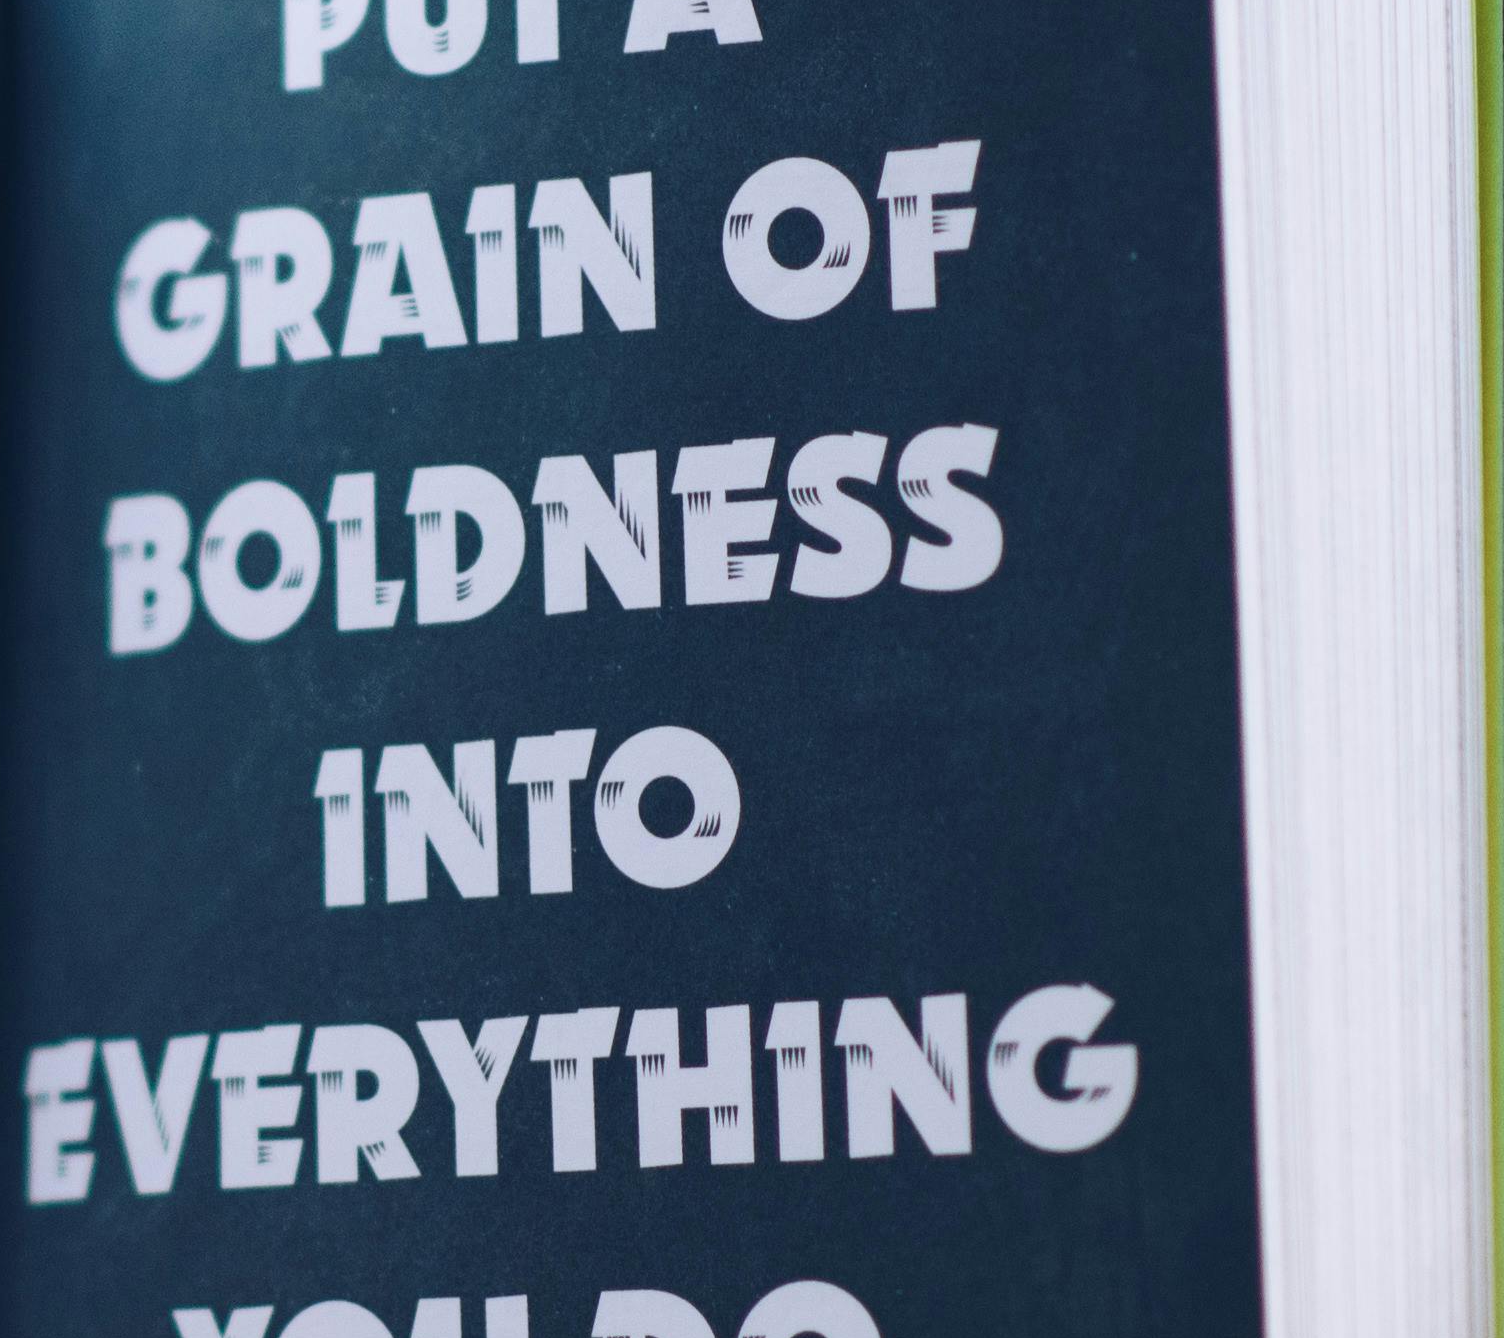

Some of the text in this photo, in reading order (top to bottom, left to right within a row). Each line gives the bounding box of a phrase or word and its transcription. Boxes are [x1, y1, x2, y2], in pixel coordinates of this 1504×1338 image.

[115, 139, 982, 382] GRAIN OF
[104, 423, 1004, 655] BOLDNESS
[313, 725, 741, 908] INTO
[25, 984, 1138, 1204] EVERYTHING
